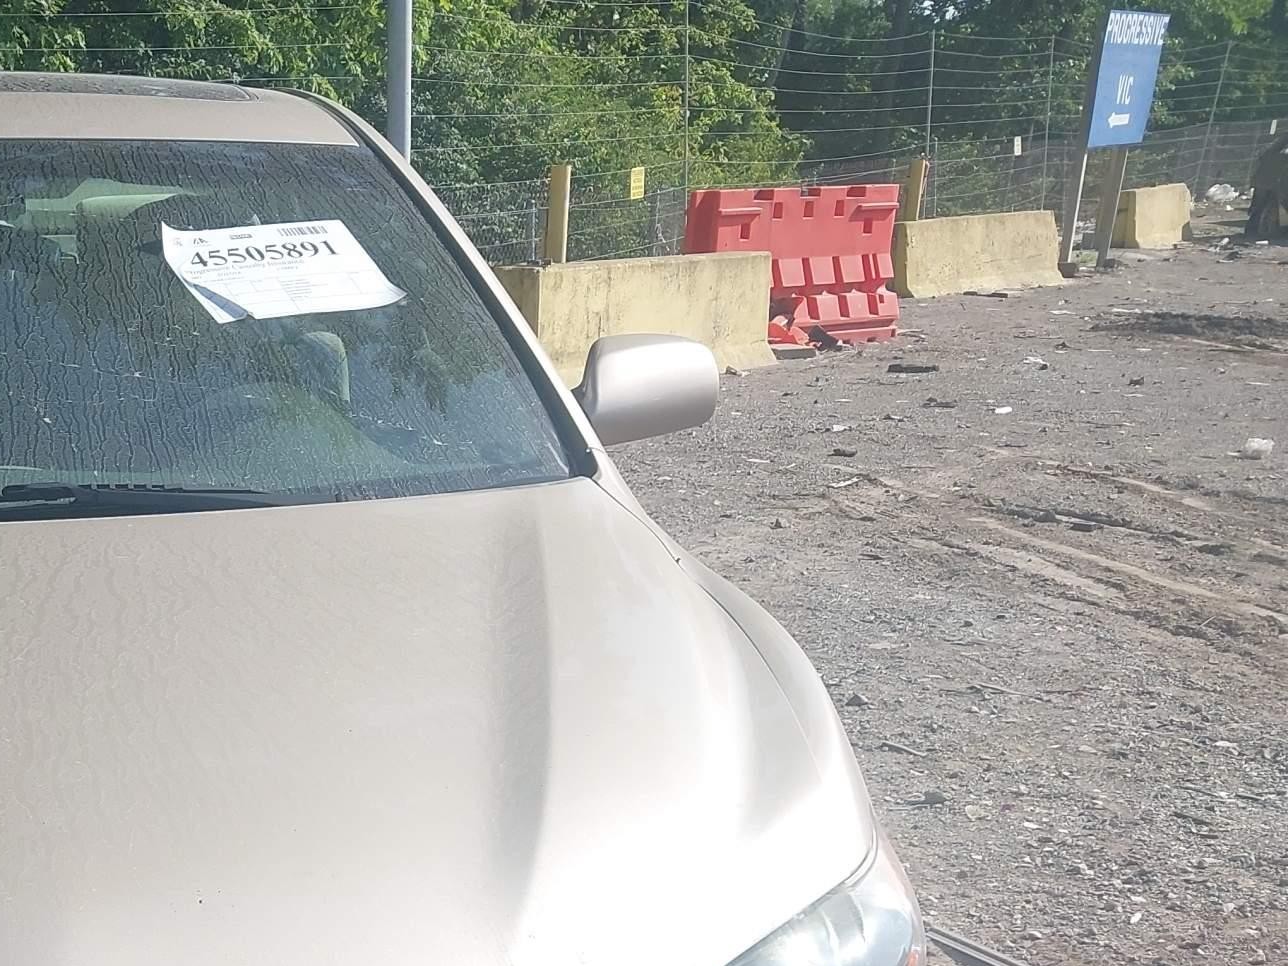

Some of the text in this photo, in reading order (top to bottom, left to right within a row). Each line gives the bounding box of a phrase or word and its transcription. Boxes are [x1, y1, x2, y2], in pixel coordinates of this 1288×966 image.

[1105, 12, 1170, 45] PROGRESSIVE
[1116, 74, 1134, 105] VIC
[190, 240, 339, 267] 45505891
